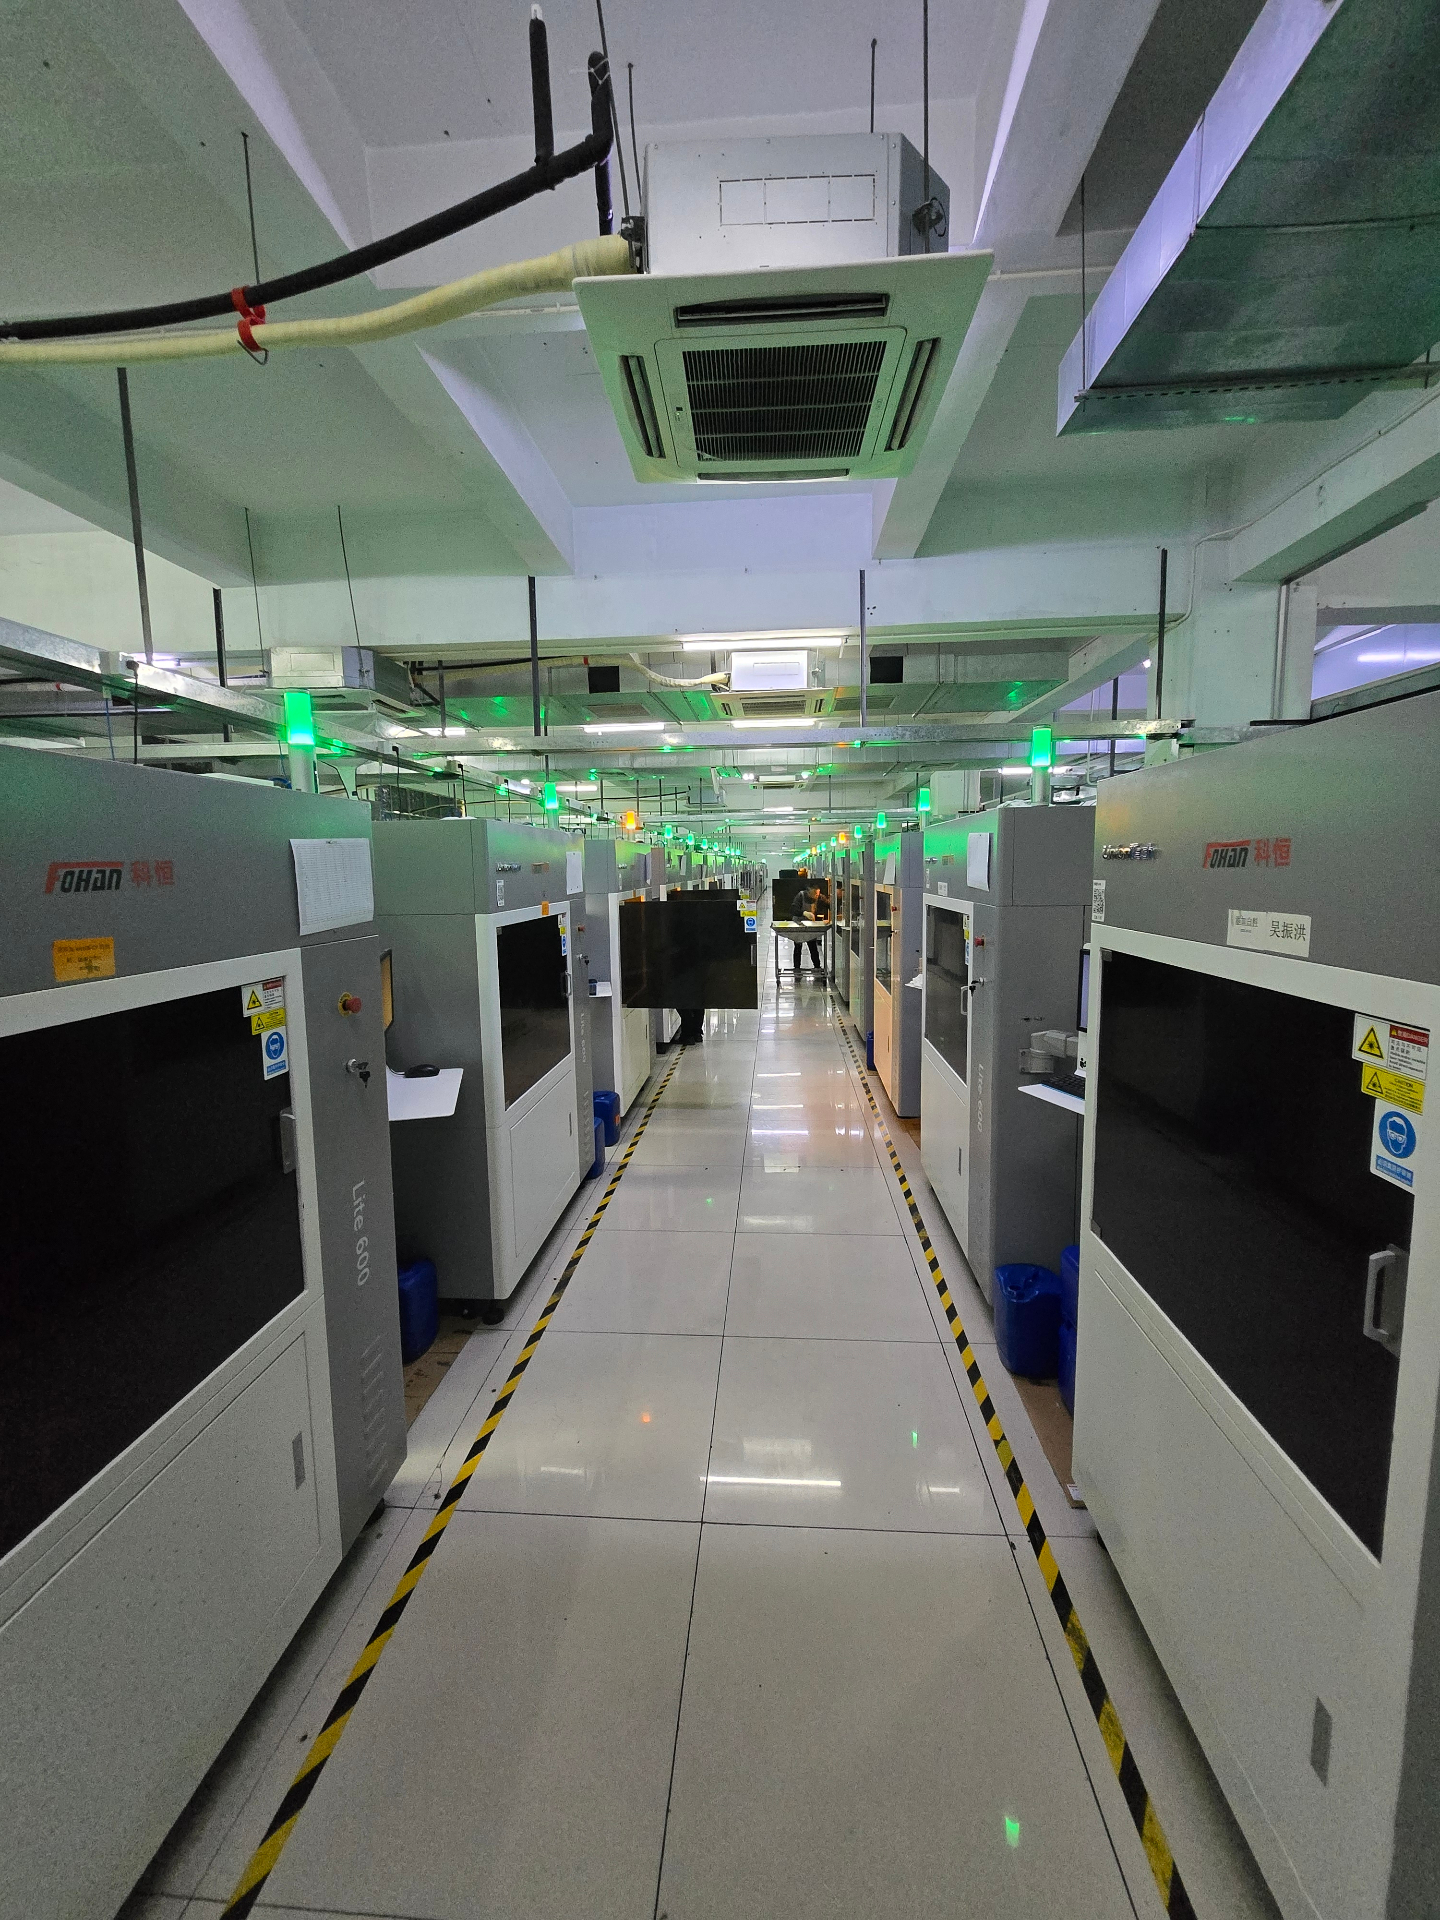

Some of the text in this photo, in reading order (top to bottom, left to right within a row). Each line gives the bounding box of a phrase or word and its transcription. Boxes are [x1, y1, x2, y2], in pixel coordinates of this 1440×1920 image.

[1254, 838, 1291, 867] 科恒
[1270, 920, 1307, 942] 吴振洪
[352, 1178, 370, 1287] Lite 600
